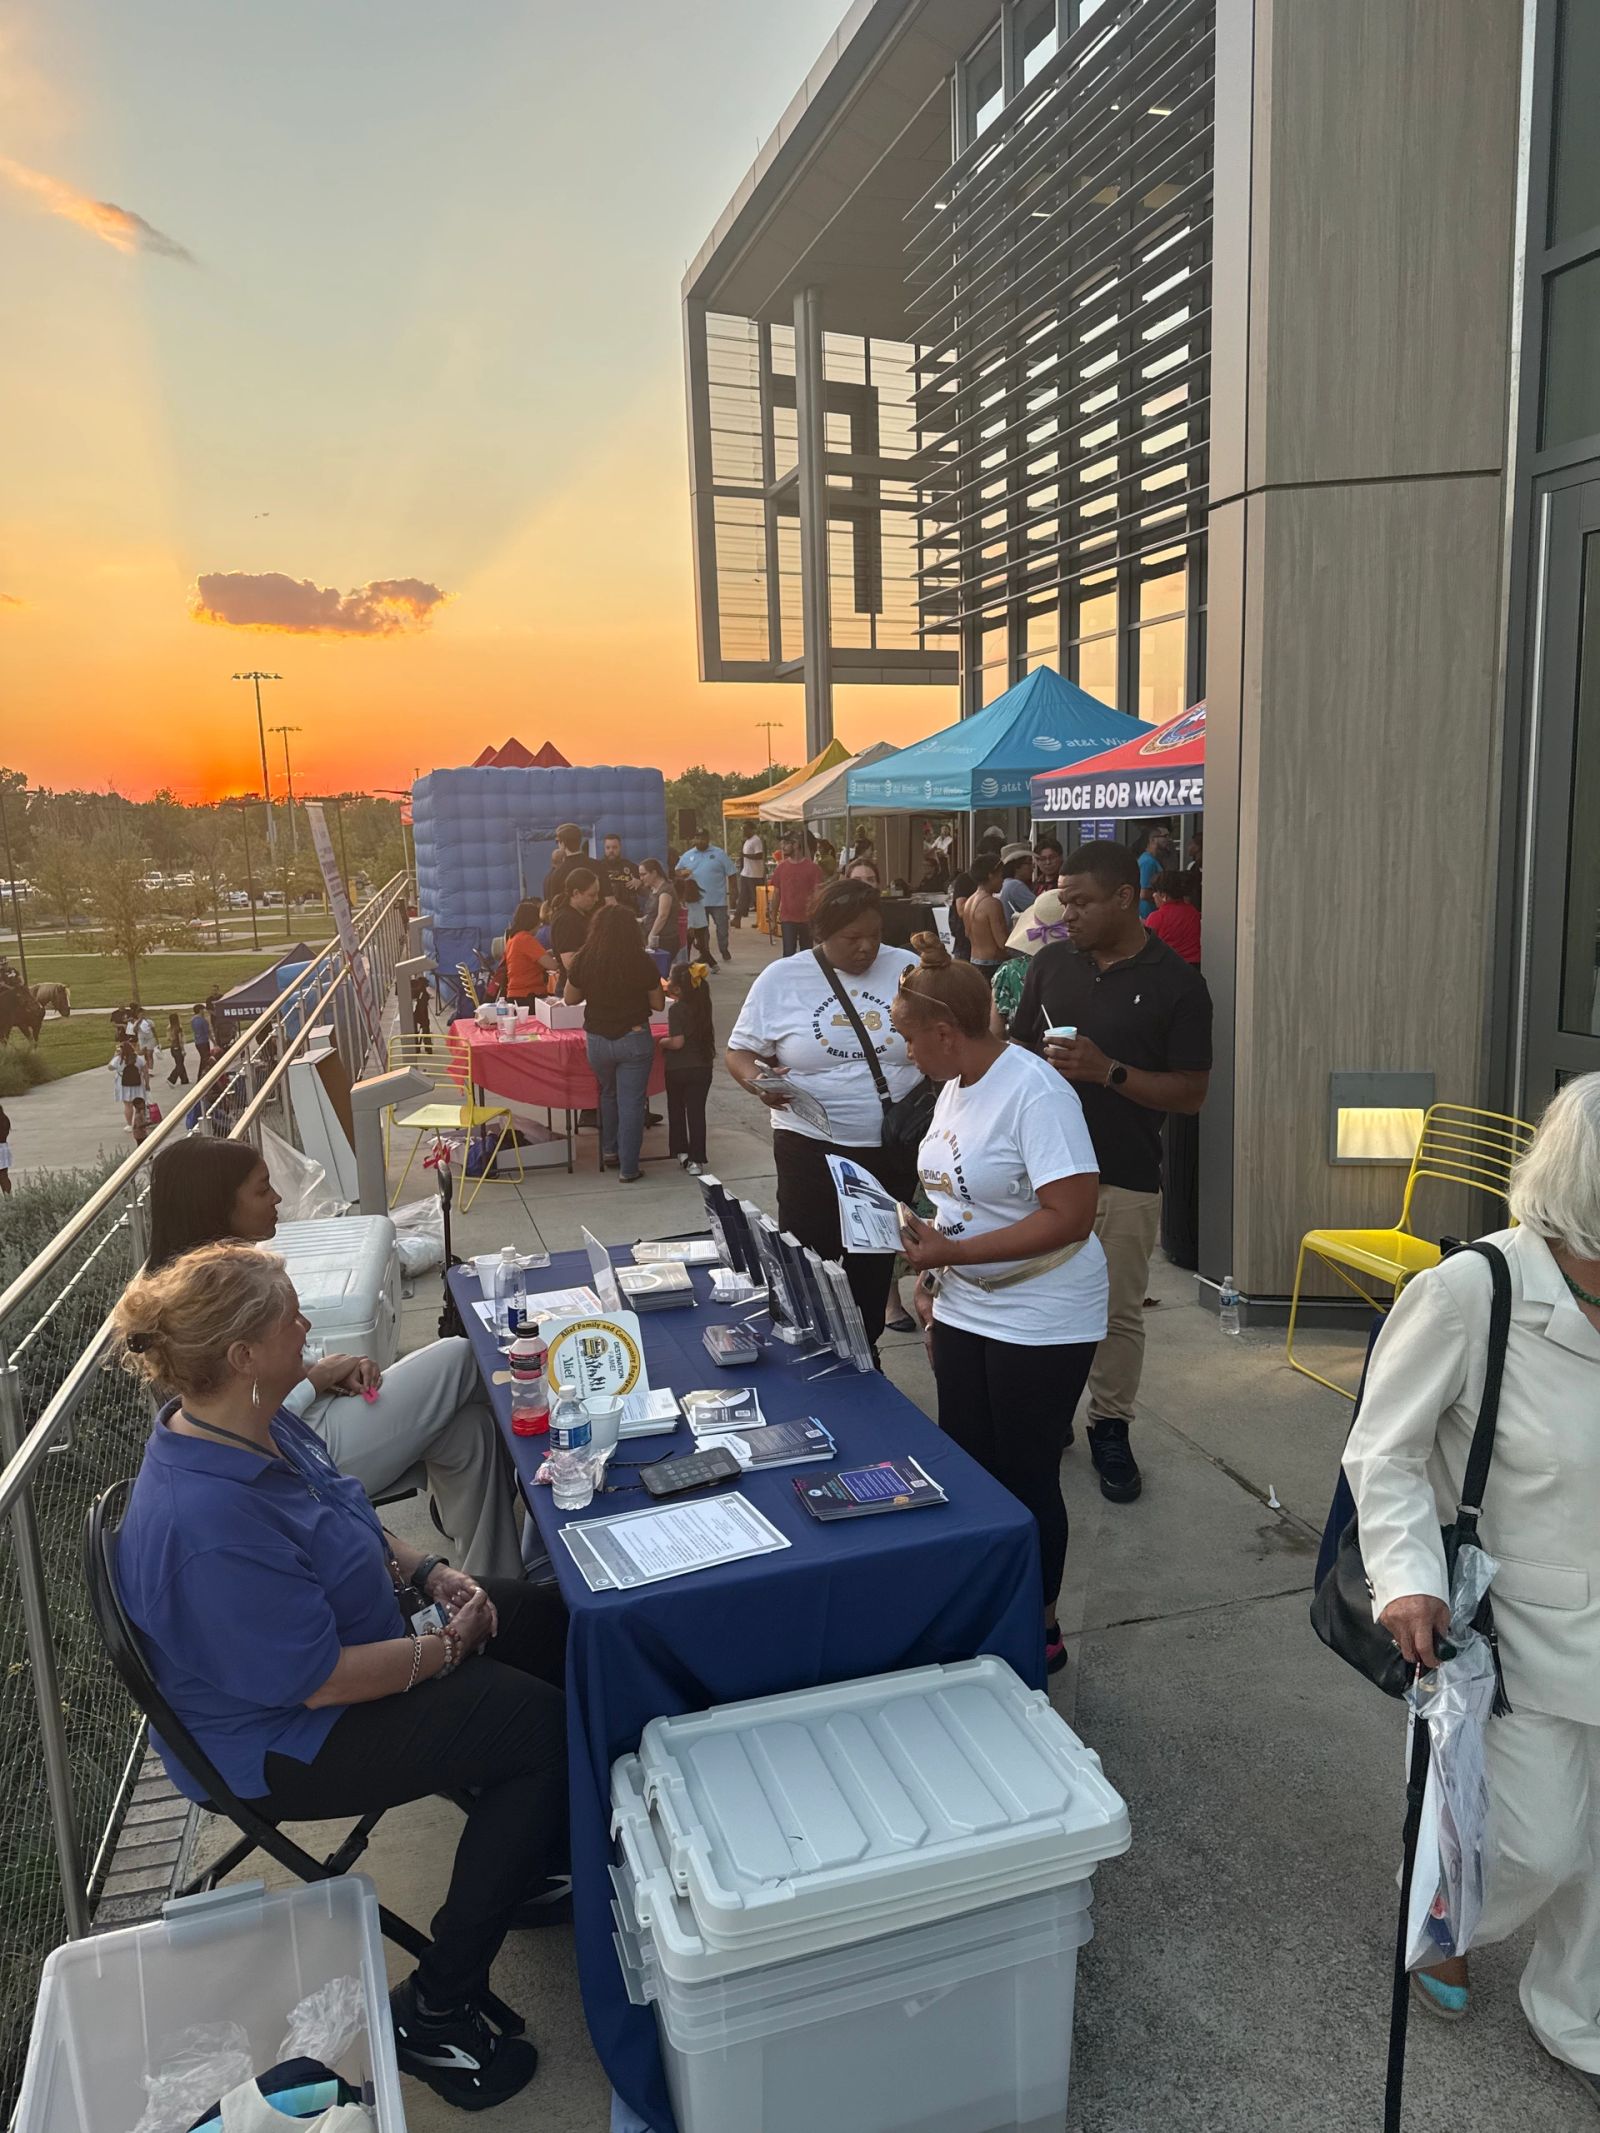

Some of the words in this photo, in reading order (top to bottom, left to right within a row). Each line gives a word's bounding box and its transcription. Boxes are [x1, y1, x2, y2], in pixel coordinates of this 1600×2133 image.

[1001, 781, 1022, 792] at&t
[1043, 785, 1091, 812] JUDGE
[1095, 782, 1130, 809] BOB
[1135, 778, 1203, 807] WOLFE
[861, 991, 885, 1006] Real
[811, 1020, 824, 1040] Real
[826, 1046, 849, 1059] REAL
[852, 1044, 888, 1059] CHGE
[948, 1134, 962, 1161] Real
[954, 1165, 976, 1206] peopl
[937, 1222, 965, 1236] HANGE
[602, 1323, 616, 1332] and
[615, 1329, 637, 1364] Community
[613, 1341, 625, 1379] DESTINATION
